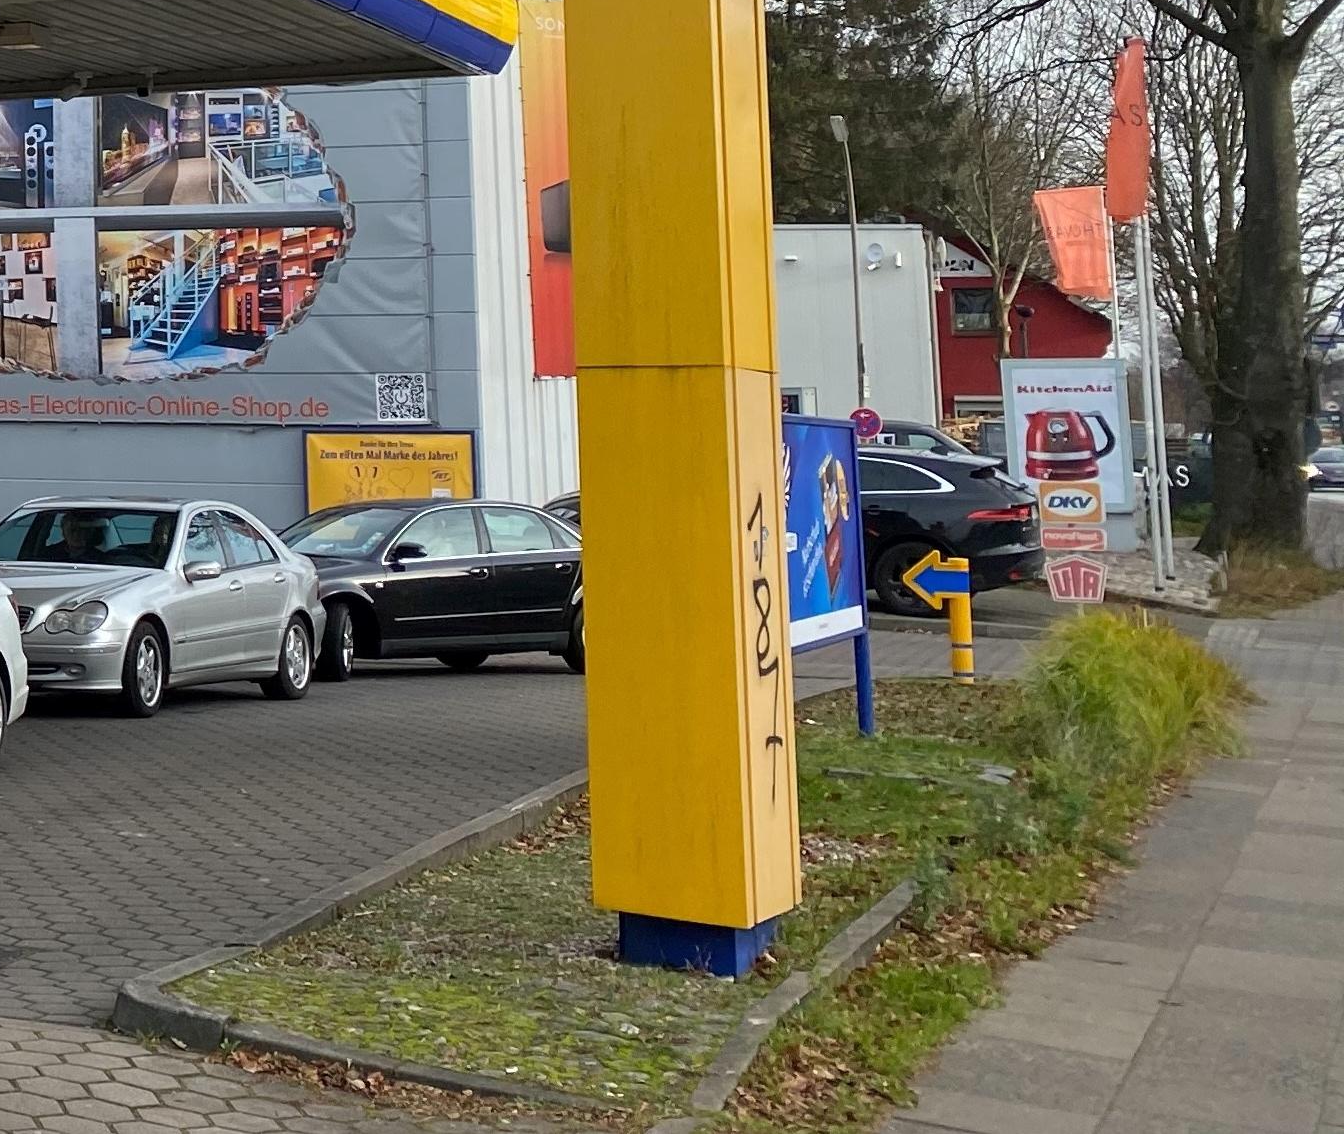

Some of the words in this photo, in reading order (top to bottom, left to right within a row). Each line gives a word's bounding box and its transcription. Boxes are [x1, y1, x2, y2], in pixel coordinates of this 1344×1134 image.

[1016, 384, 1113, 394] KitchenAid
[320, 450, 338, 460] Zum
[365, 450, 382, 460] Mal
[383, 450, 410, 461] Marke
[411, 451, 426, 461] des
[1047, 495, 1093, 509] DKV
[1051, 560, 1101, 599] UTA
